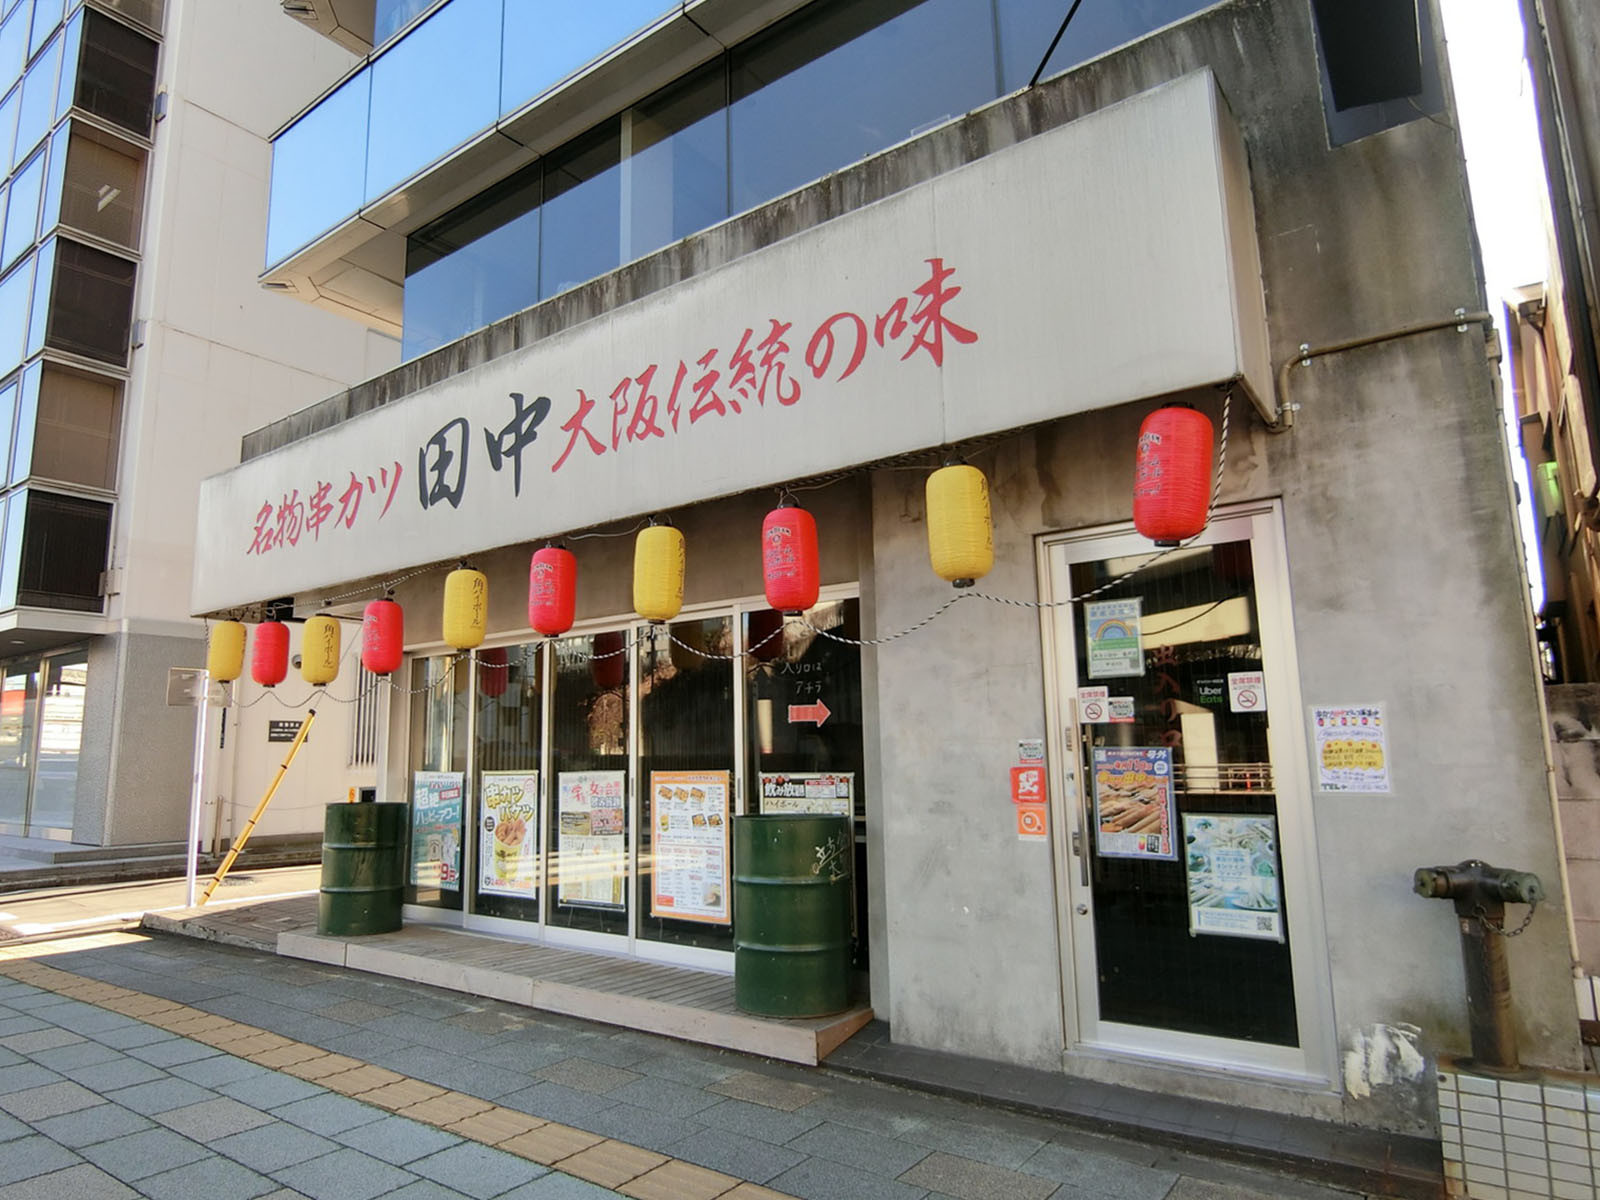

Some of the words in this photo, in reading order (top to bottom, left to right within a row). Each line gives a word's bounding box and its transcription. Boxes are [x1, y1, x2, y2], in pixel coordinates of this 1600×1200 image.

[1199, 687, 1221, 695] Uber
[1200, 695, 1222, 703] Eats
[484, 783, 525, 809] 串カツ
